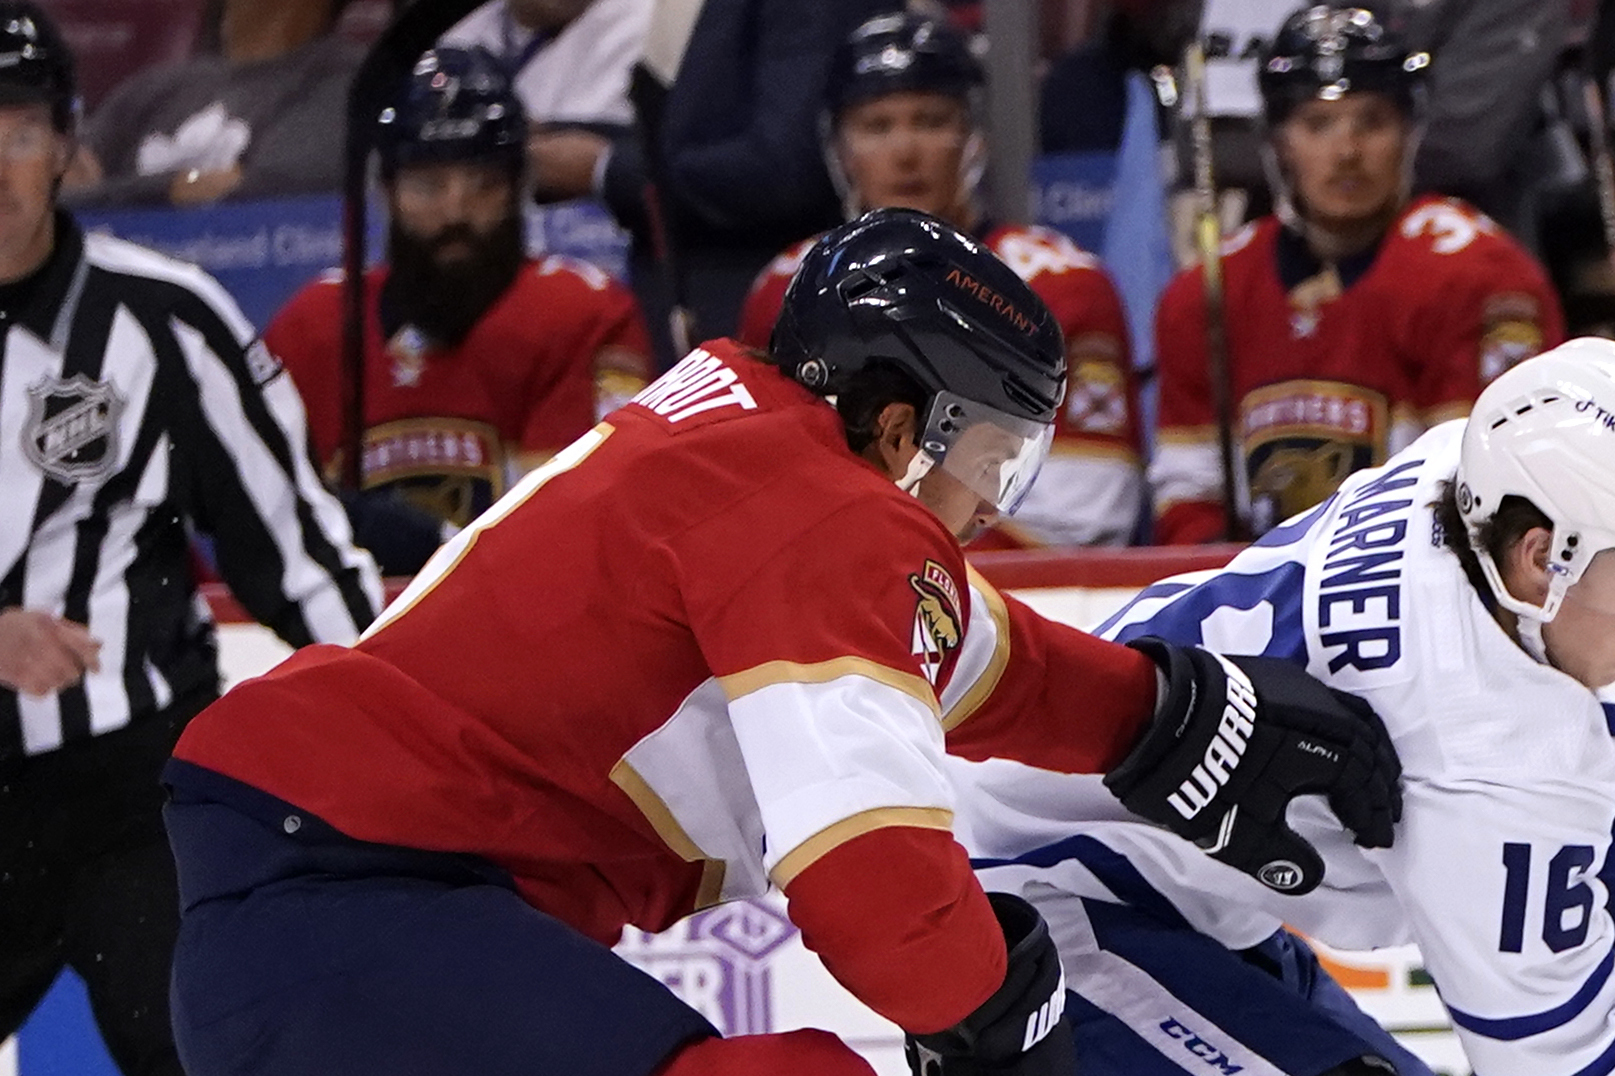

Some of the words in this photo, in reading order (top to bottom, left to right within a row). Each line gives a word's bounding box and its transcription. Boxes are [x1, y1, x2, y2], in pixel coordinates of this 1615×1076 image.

[946, 269, 1038, 337] AMERANT
[1317, 459, 1426, 677] MARNER
[1499, 842, 1595, 954] 16
[1159, 1015, 1245, 1076] CCM
